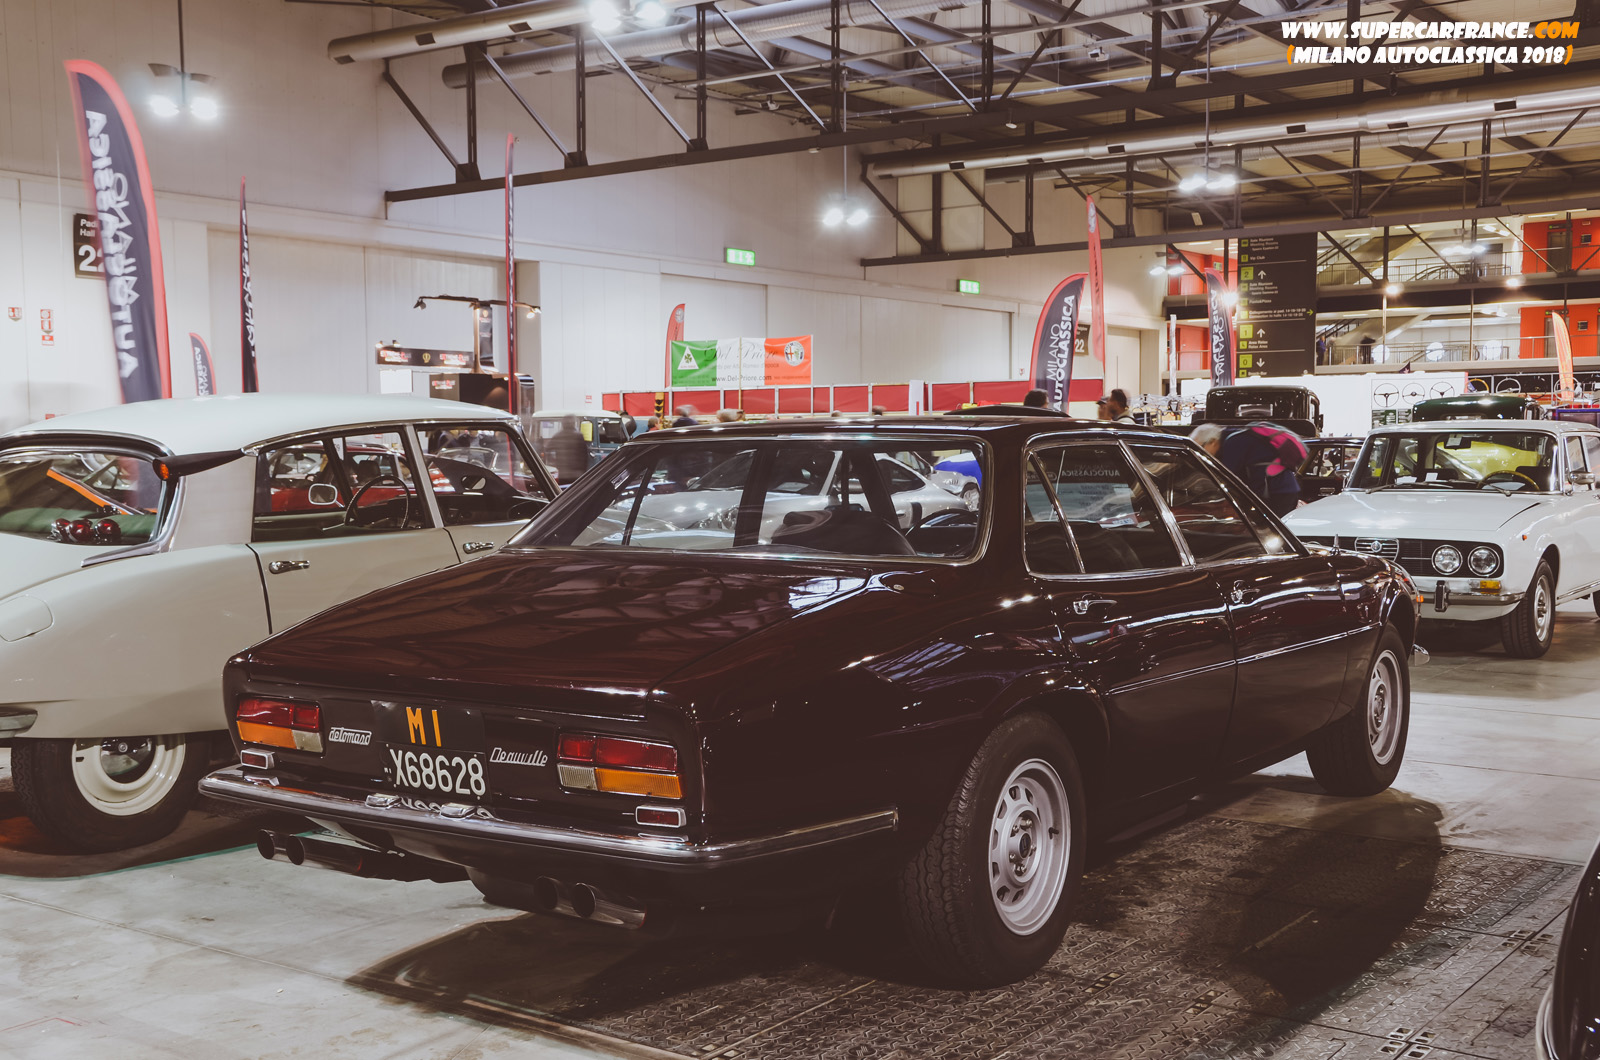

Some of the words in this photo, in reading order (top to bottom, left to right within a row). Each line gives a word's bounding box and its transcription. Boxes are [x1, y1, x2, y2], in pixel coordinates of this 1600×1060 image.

[1046, 323, 1061, 381] MILANO
[1053, 295, 1075, 412] AUTOCLASSICA
[1075, 338, 1085, 353] 22
[389, 748, 486, 796] X68628
[490, 747, 548, 767] Deauville
